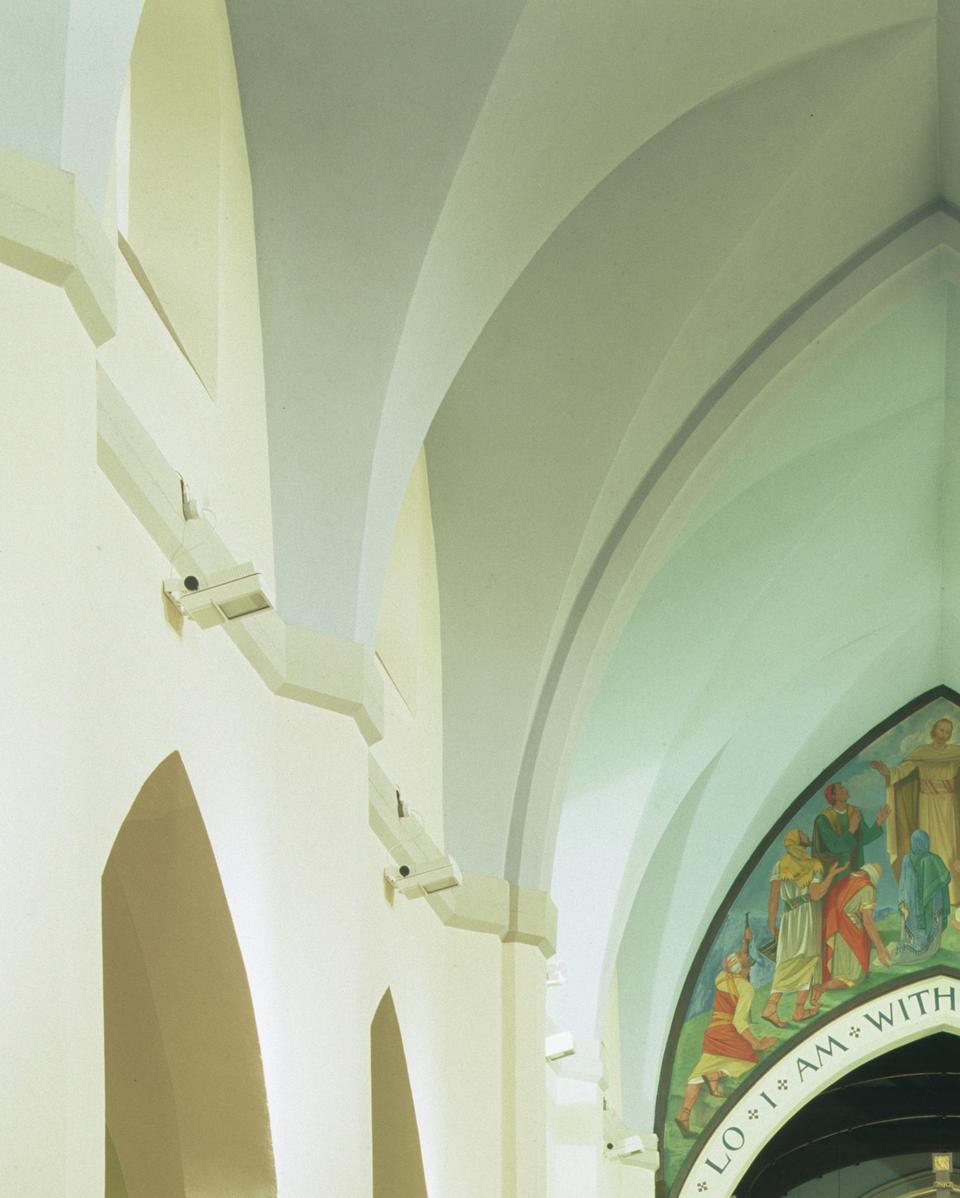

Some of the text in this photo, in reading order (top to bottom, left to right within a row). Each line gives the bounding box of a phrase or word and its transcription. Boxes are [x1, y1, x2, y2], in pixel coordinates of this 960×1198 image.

[704, 1125, 746, 1175] LO
[759, 1091, 778, 1109] I
[796, 1035, 849, 1083] AM
[863, 986, 956, 1033] WITH
